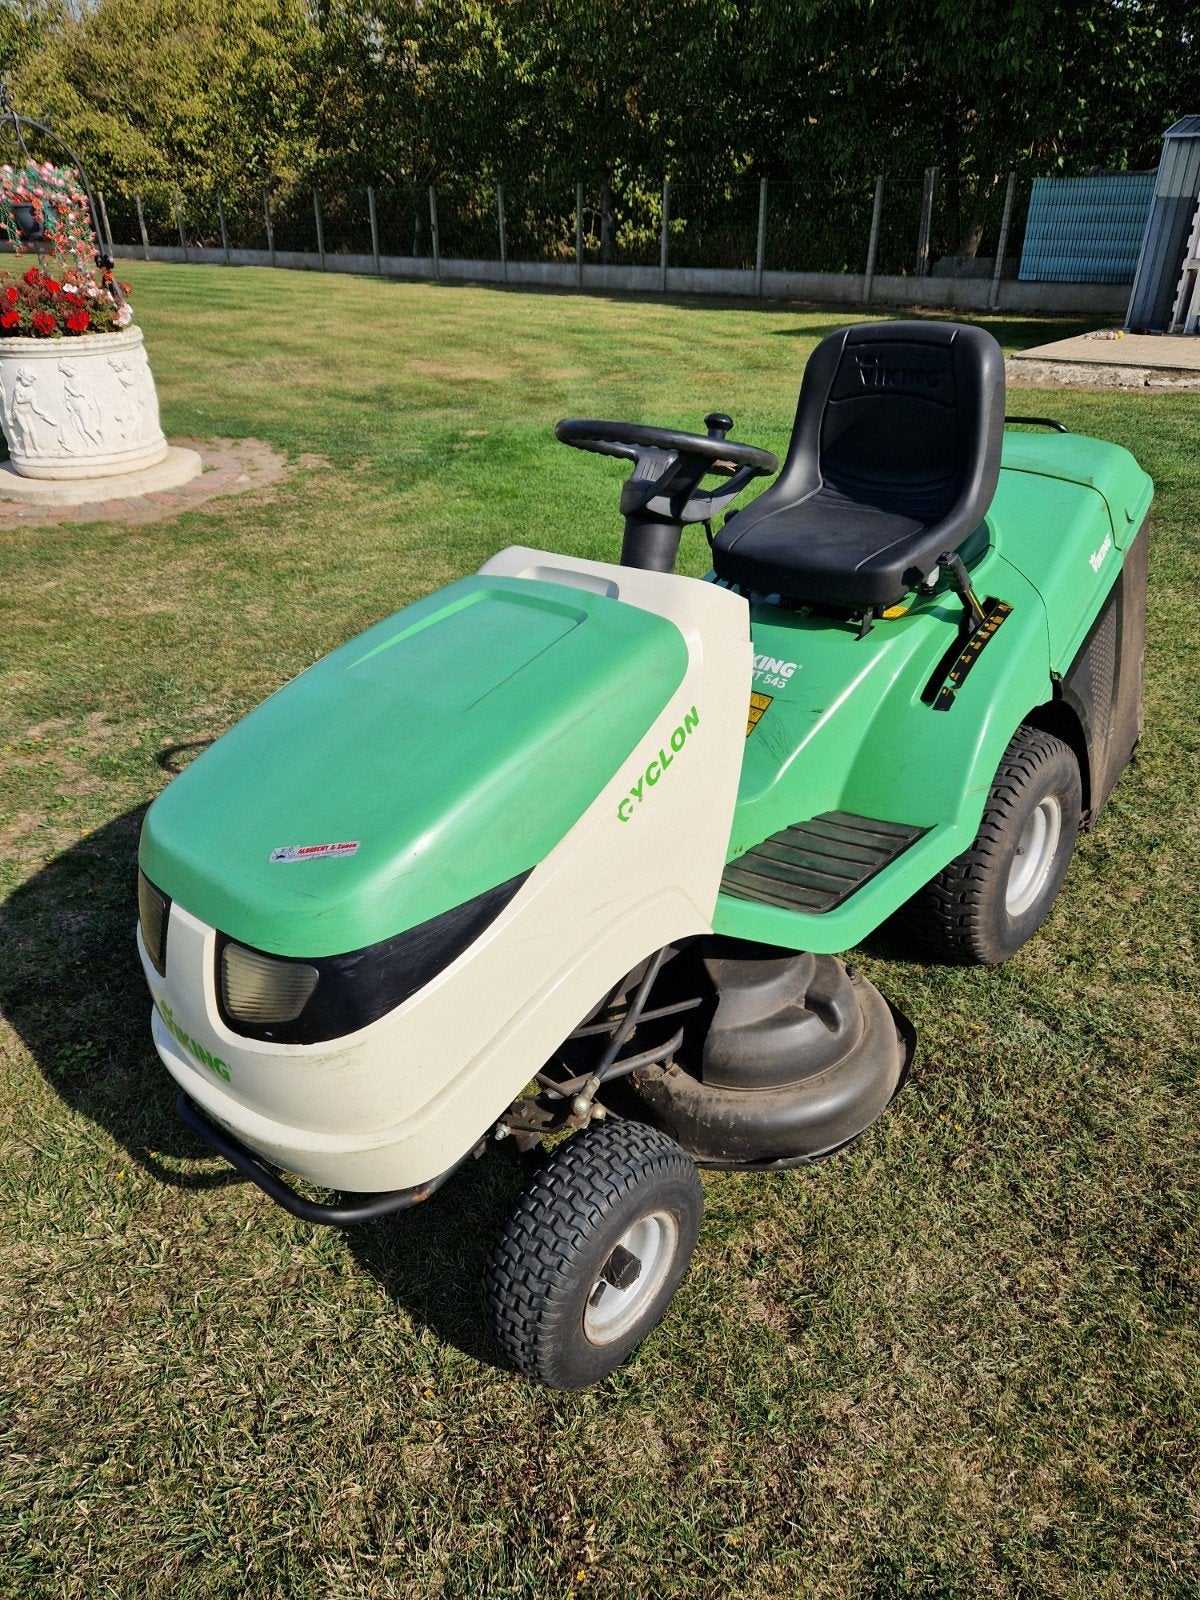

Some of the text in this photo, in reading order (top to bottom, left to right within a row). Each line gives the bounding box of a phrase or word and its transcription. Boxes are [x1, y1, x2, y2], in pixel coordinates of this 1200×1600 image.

[752, 654, 798, 678] KING
[763, 674, 788, 688] 545
[617, 705, 700, 822] CYCLON
[160, 1000, 231, 1083] VIKING
